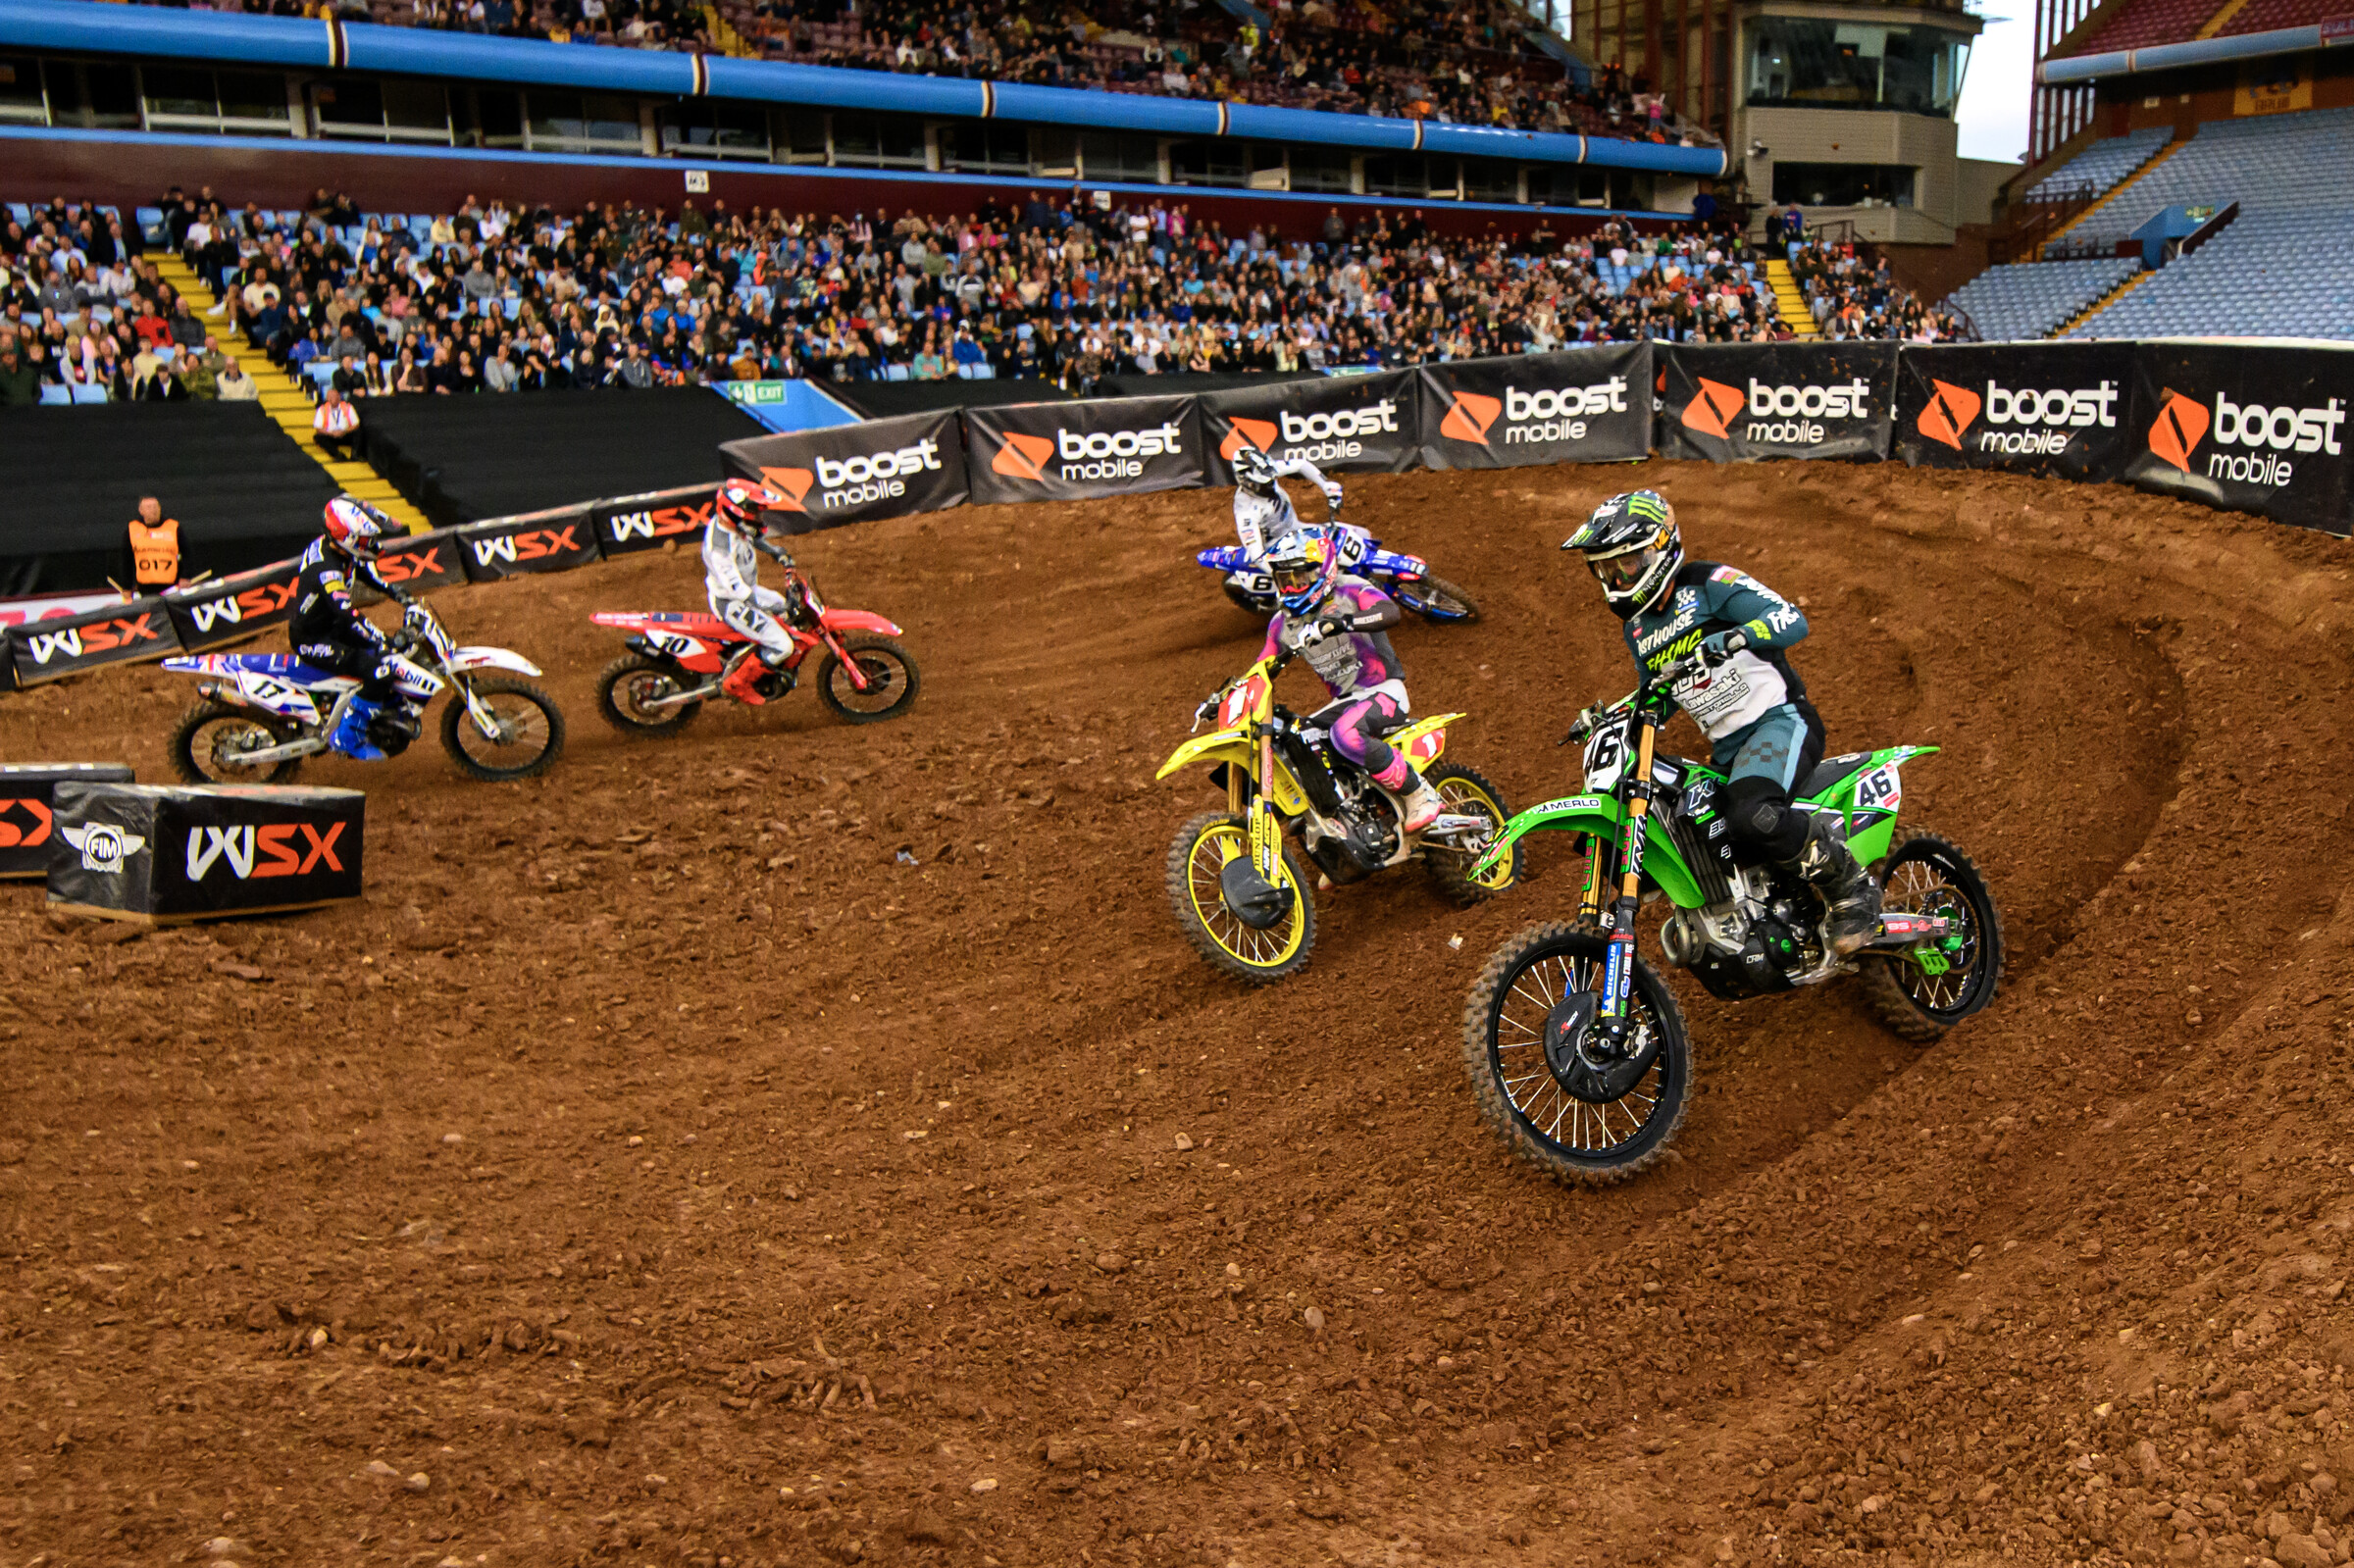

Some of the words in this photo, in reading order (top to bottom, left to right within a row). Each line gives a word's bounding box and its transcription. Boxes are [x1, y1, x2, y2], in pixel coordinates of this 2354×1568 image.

[757, 385, 782, 399] EXIT
[1505, 377, 1628, 421] boost
[1749, 378, 1869, 419] boost
[1986, 379, 2118, 428] boost
[1280, 398, 1399, 442] boost
[1505, 418, 1586, 444] mobile
[1747, 420, 1824, 442] mobile
[2215, 392, 2345, 455] boost
[1058, 422, 1181, 461] boost
[1284, 439, 1362, 461] mobile
[1980, 429, 2067, 455] mobile
[816, 437, 941, 487] boost
[1061, 457, 1143, 482] mobile
[2209, 453, 2292, 486] mobile
[823, 478, 905, 508] mobile
[611, 501, 714, 542] WSX
[473, 526, 581, 567] WSX
[1343, 535, 1361, 562] 6
[139, 559, 172, 571] 017
[376, 547, 444, 583] SX
[1253, 576, 1273, 590] 6
[28, 612, 158, 664] WSX
[1636, 608, 1696, 656] STHOUSE
[253, 681, 287, 699] 17
[1228, 685, 1248, 724] 1
[1421, 733, 1437, 760] 1
[1551, 799, 1599, 810] MERLO
[1860, 770, 1892, 807] 46
[90, 836, 118, 859] FIM
[186, 822, 346, 882] WSX
[1607, 944, 1616, 996] MICHELIN
